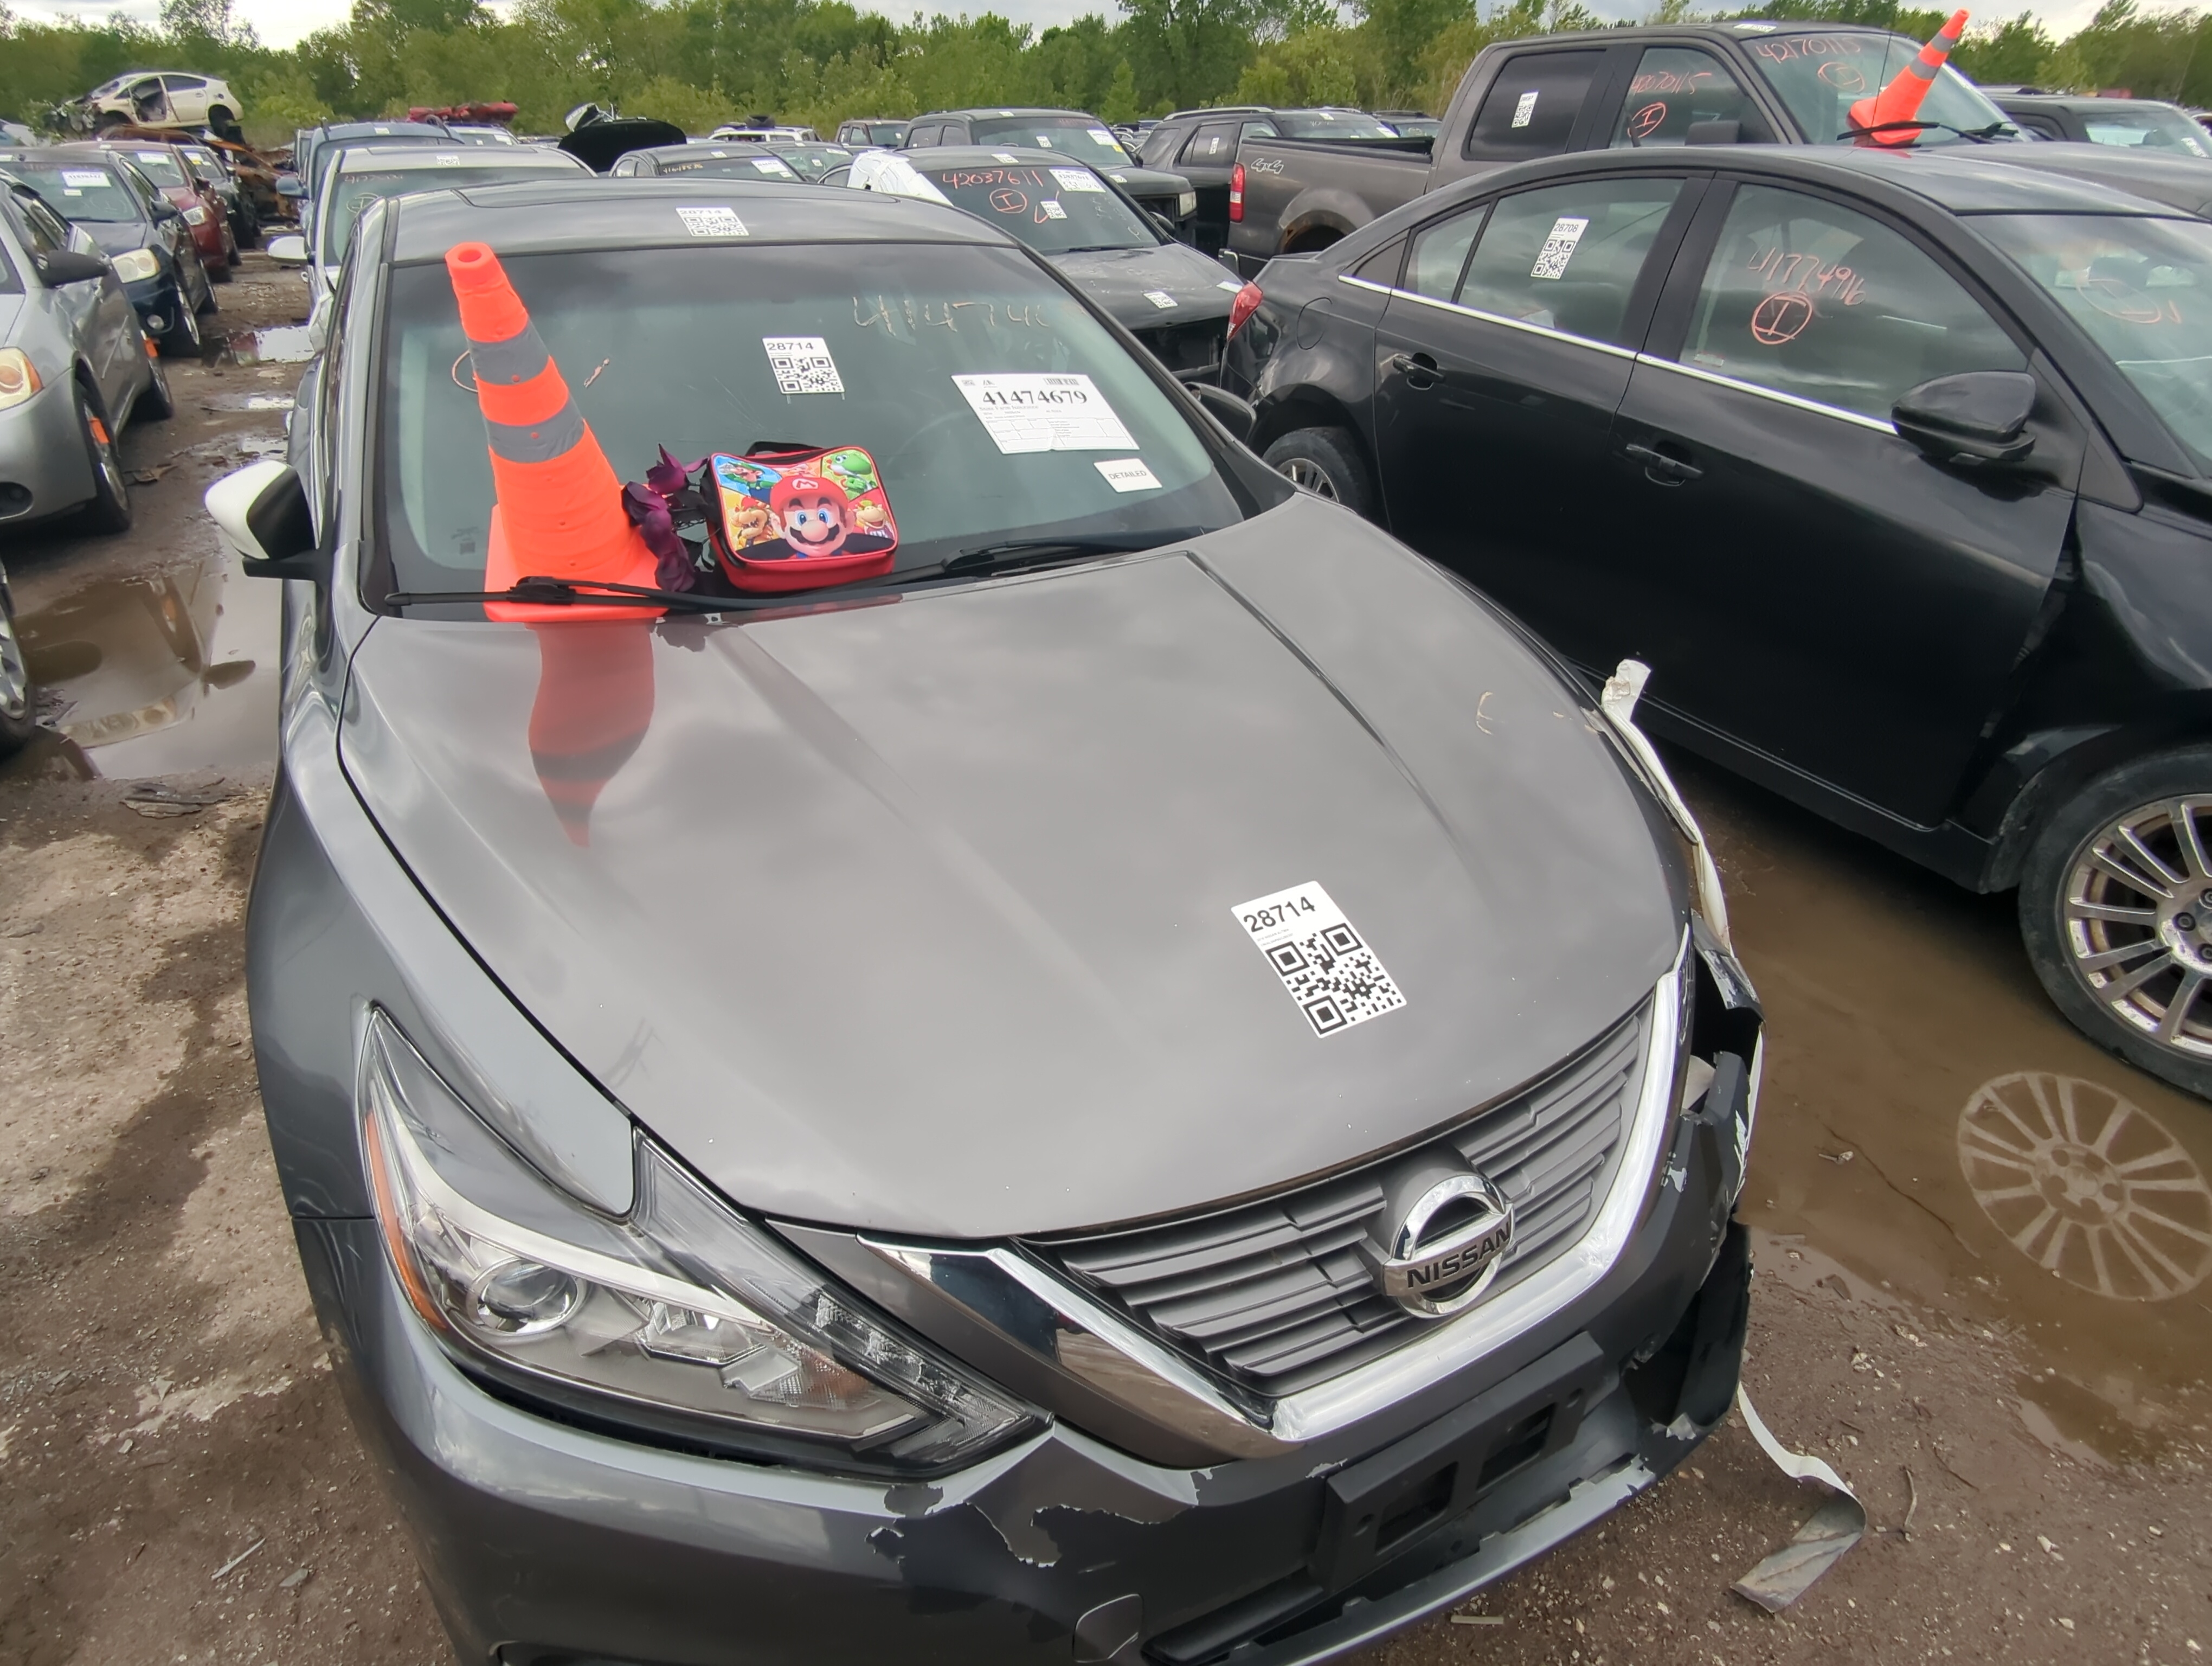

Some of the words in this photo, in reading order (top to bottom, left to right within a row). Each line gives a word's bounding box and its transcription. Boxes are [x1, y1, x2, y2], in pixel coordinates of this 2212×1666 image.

[1251, 158, 1284, 174] 4x4
[942, 170, 1044, 189] 42037611
[767, 342, 814, 350] 28714
[982, 390, 1088, 405] 41474679
[1108, 470, 1147, 480] DETAILED
[1243, 896, 1315, 932] 28714
[1406, 1222, 1510, 1289] NISSAN
